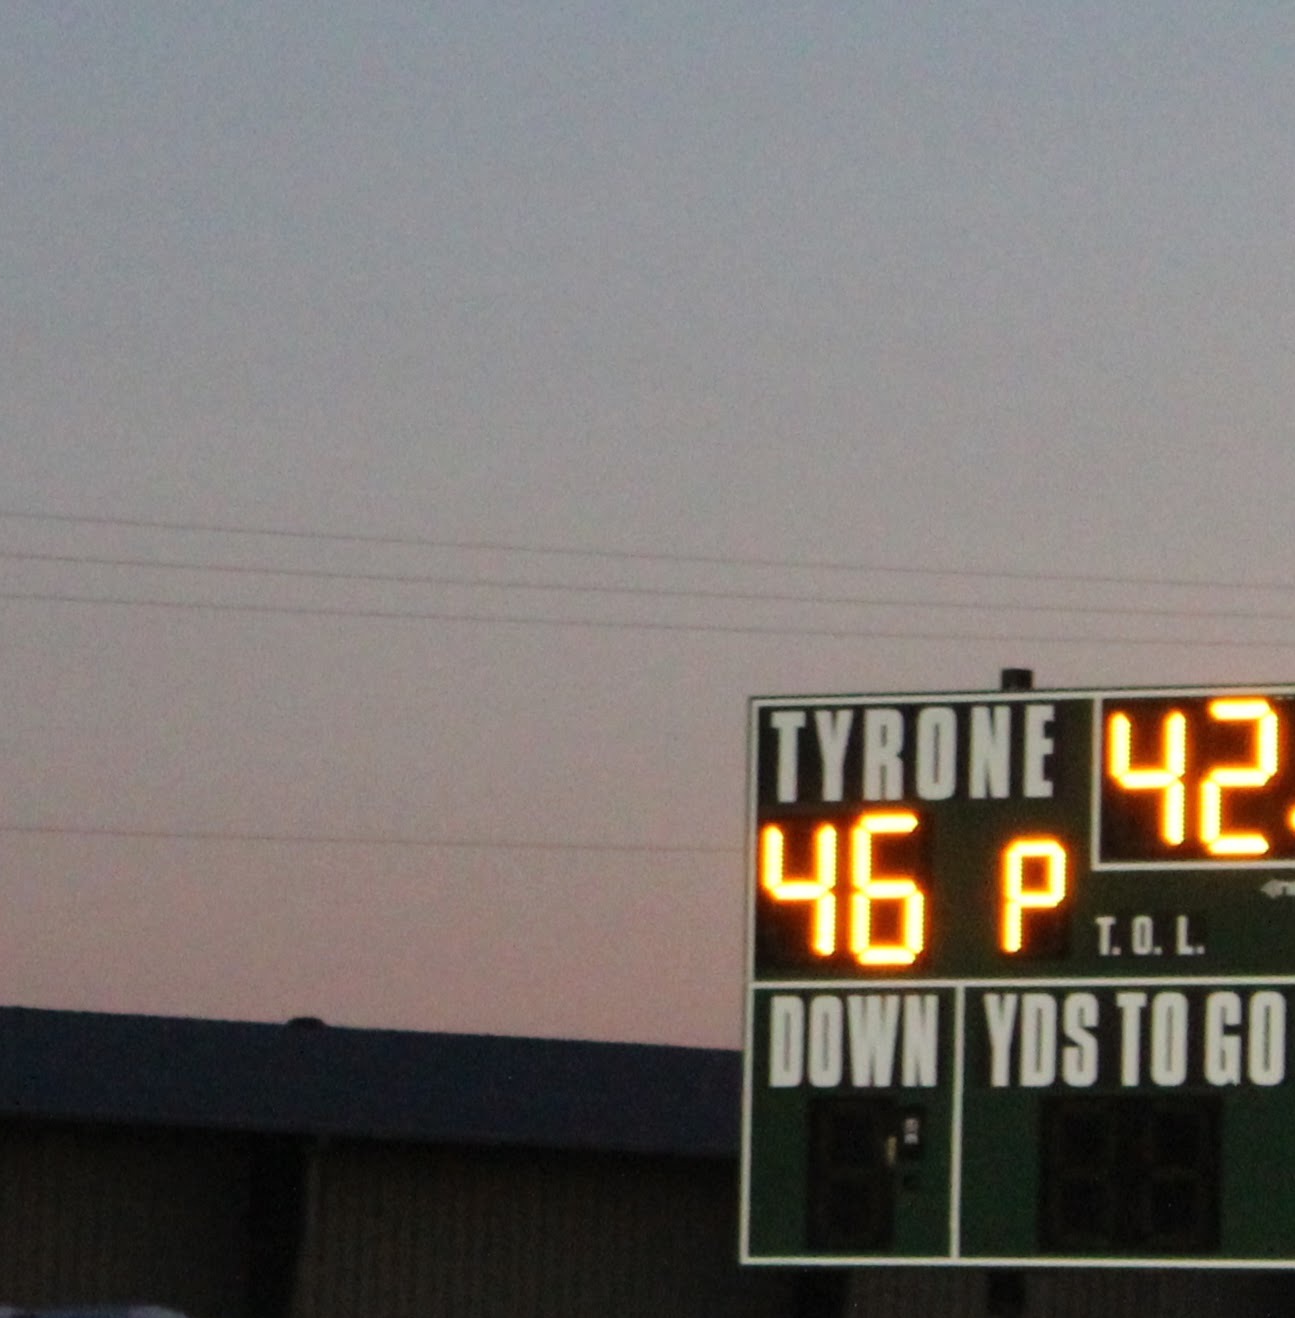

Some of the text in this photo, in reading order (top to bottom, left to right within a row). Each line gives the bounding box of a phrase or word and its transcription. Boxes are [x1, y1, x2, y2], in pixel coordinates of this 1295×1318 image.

[770, 704, 1056, 803] TYRONE
[761, 812, 925, 966] 46
[768, 994, 939, 1089] DOWN
[984, 990, 1287, 1088] YDS TO GO
